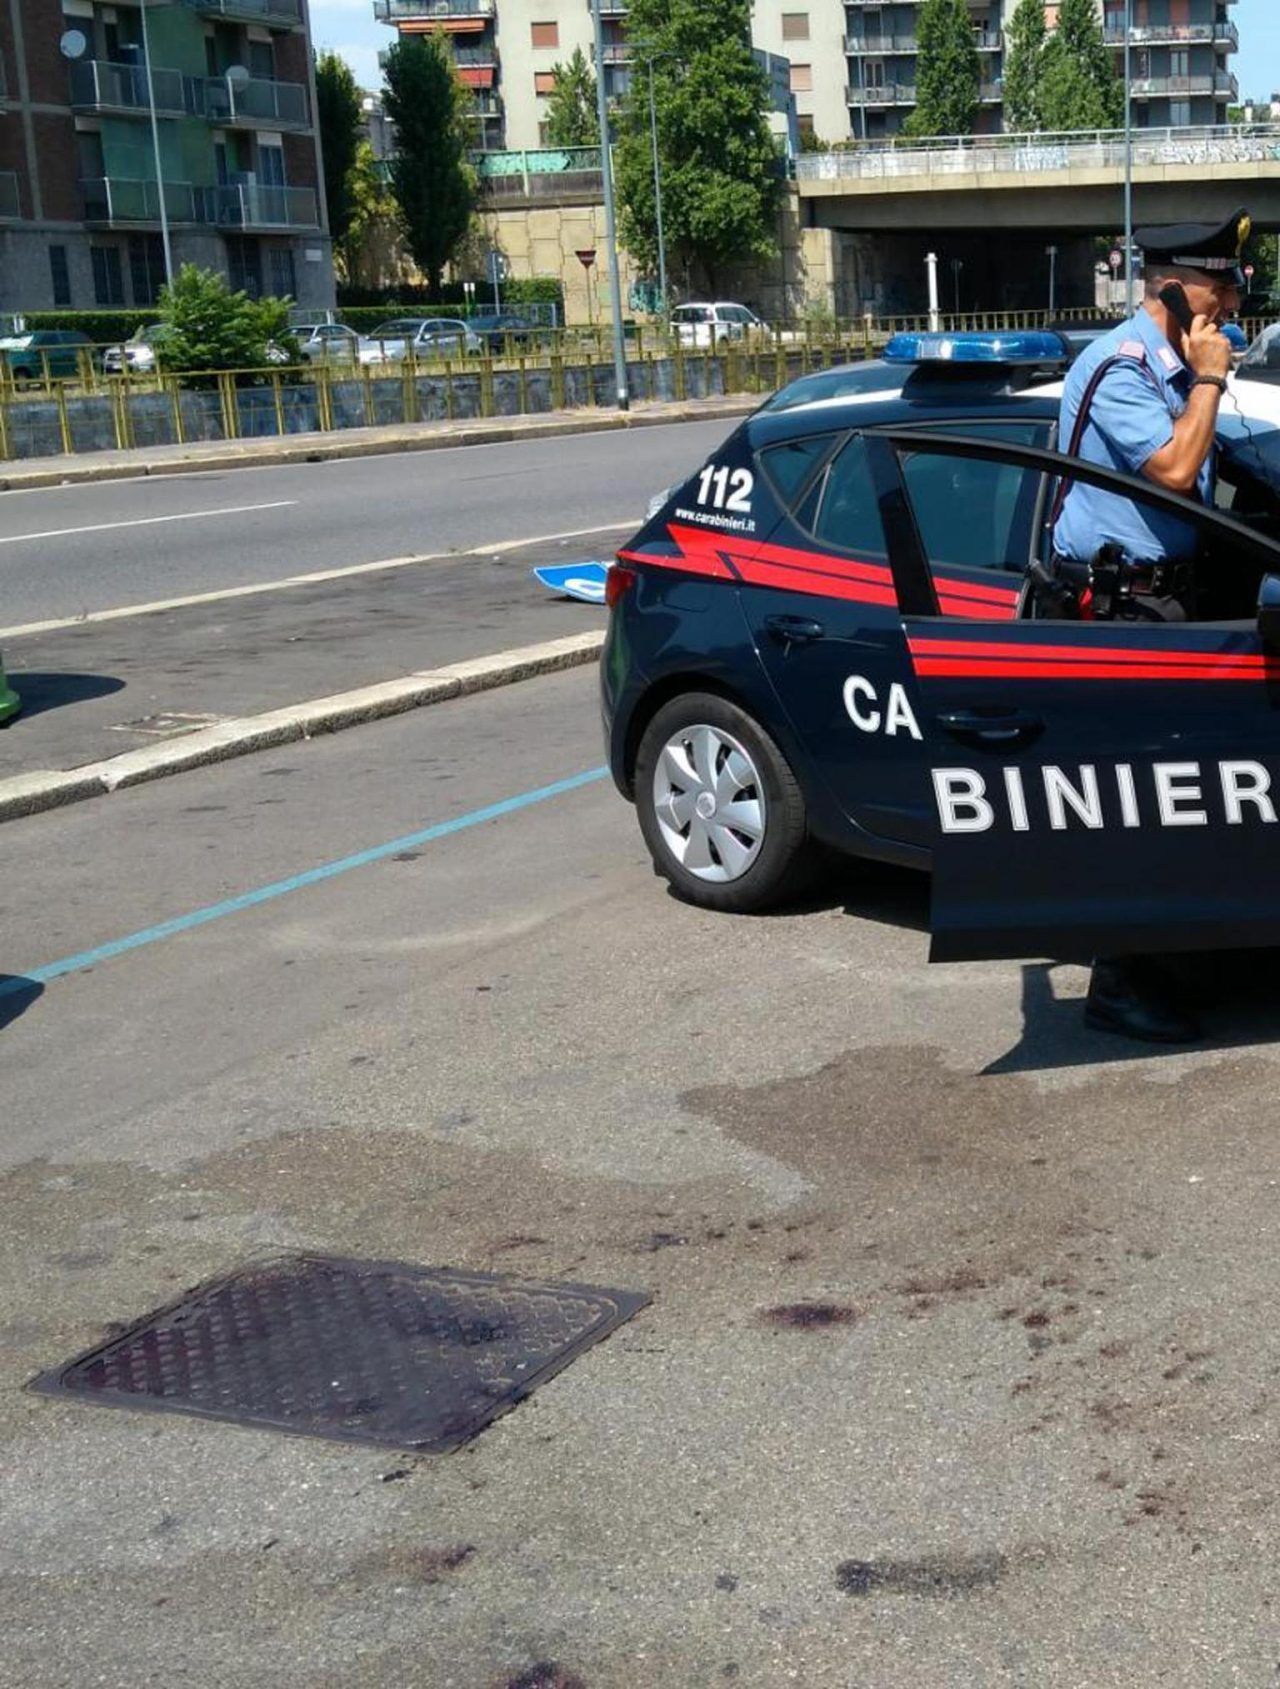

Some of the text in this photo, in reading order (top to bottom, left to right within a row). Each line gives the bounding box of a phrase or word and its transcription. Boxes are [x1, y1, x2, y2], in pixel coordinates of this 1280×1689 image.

[697, 465, 754, 512] 112
[675, 508, 756, 532] www.carabinieri.it
[843, 675, 923, 740] CA
